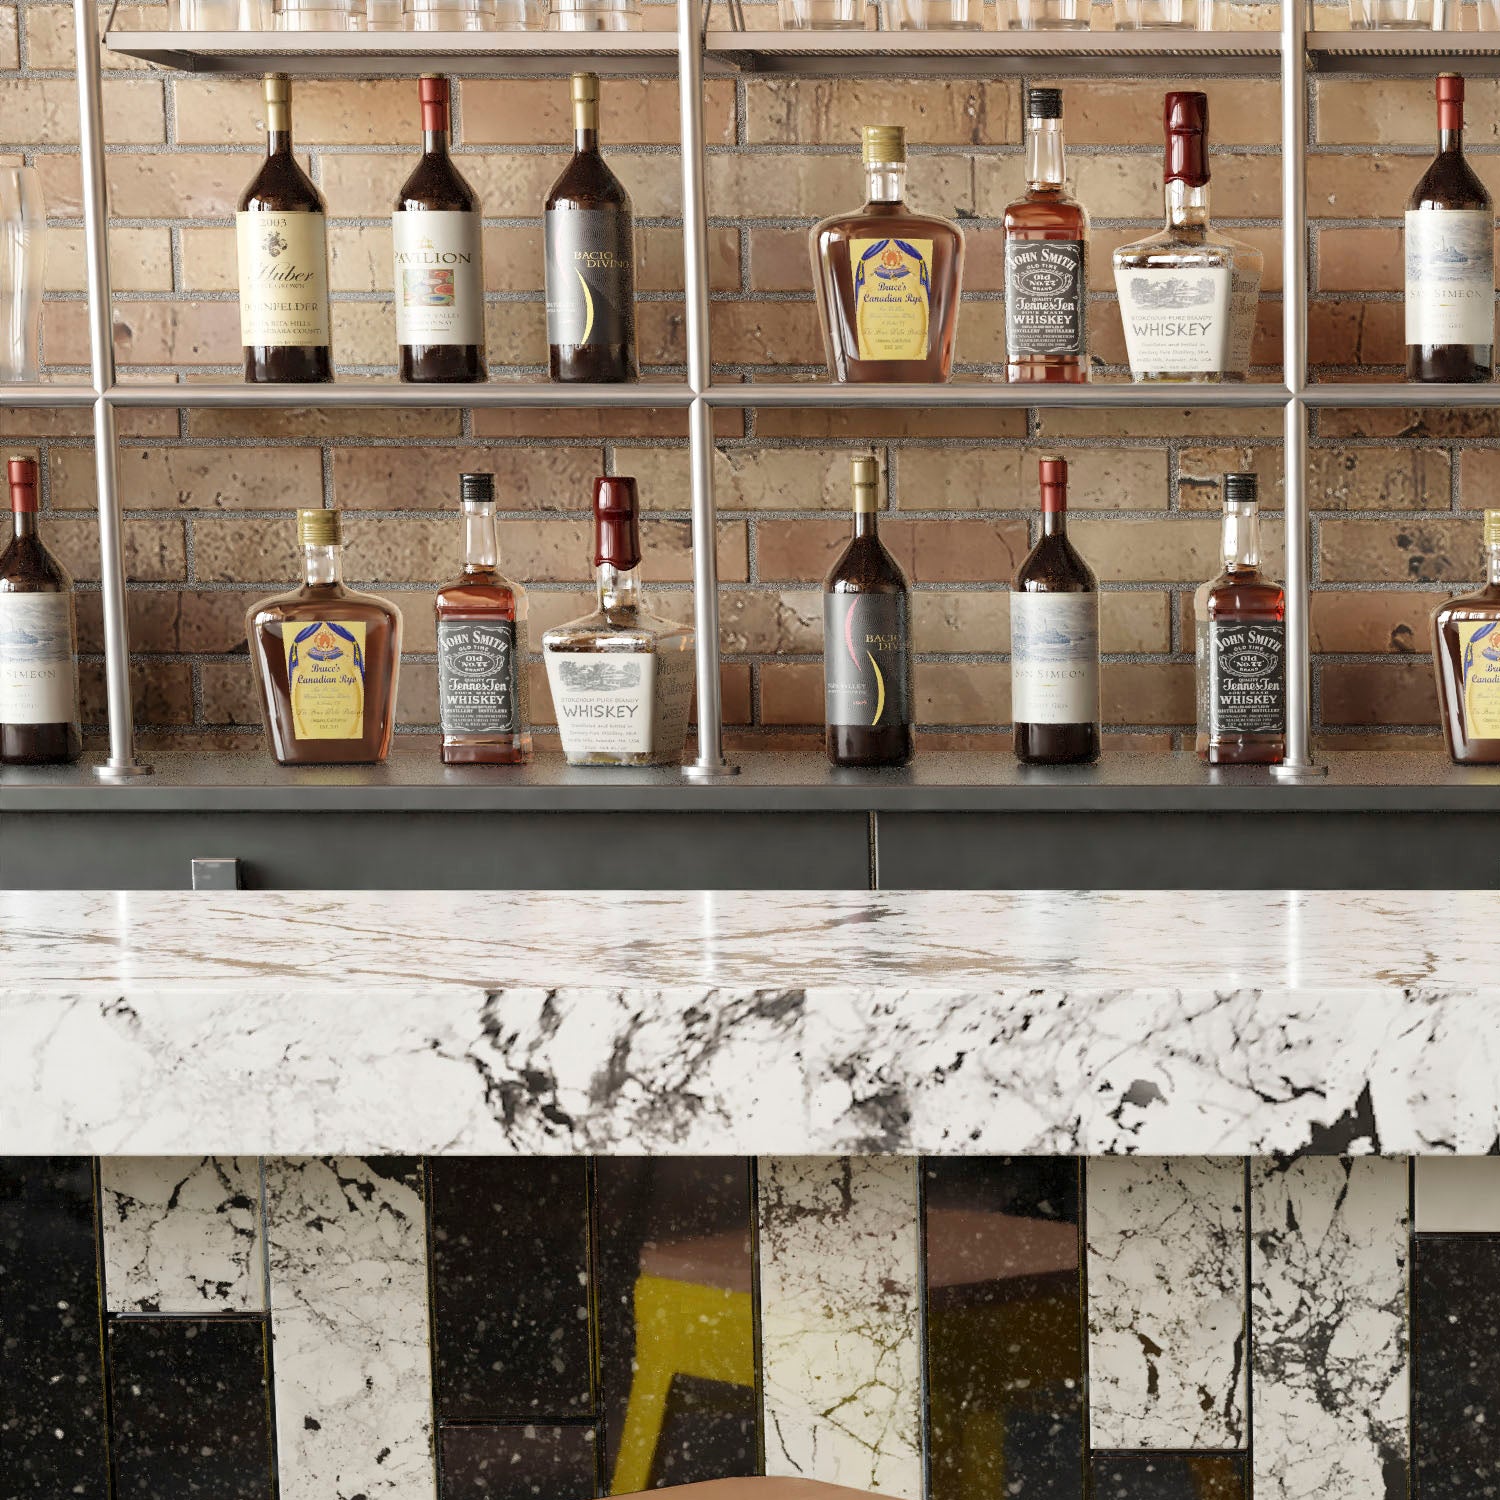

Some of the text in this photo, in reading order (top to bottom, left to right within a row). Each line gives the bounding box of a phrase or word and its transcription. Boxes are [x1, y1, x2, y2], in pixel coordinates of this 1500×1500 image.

[1011, 249, 1077, 271] JOHN SMITH
[863, 294, 902, 303] Canadian
[1013, 315, 1072, 325] WHISKEY
[1132, 322, 1212, 337] WHISKEY
[441, 630, 508, 653] JOHN SMITH
[1217, 630, 1282, 653] JOHN SMITH
[297, 675, 337, 684] Canadian
[447, 695, 505, 705] WHISKEY
[1220, 695, 1277, 705] WHISKEY
[562, 705, 639, 718] WHISKEY
